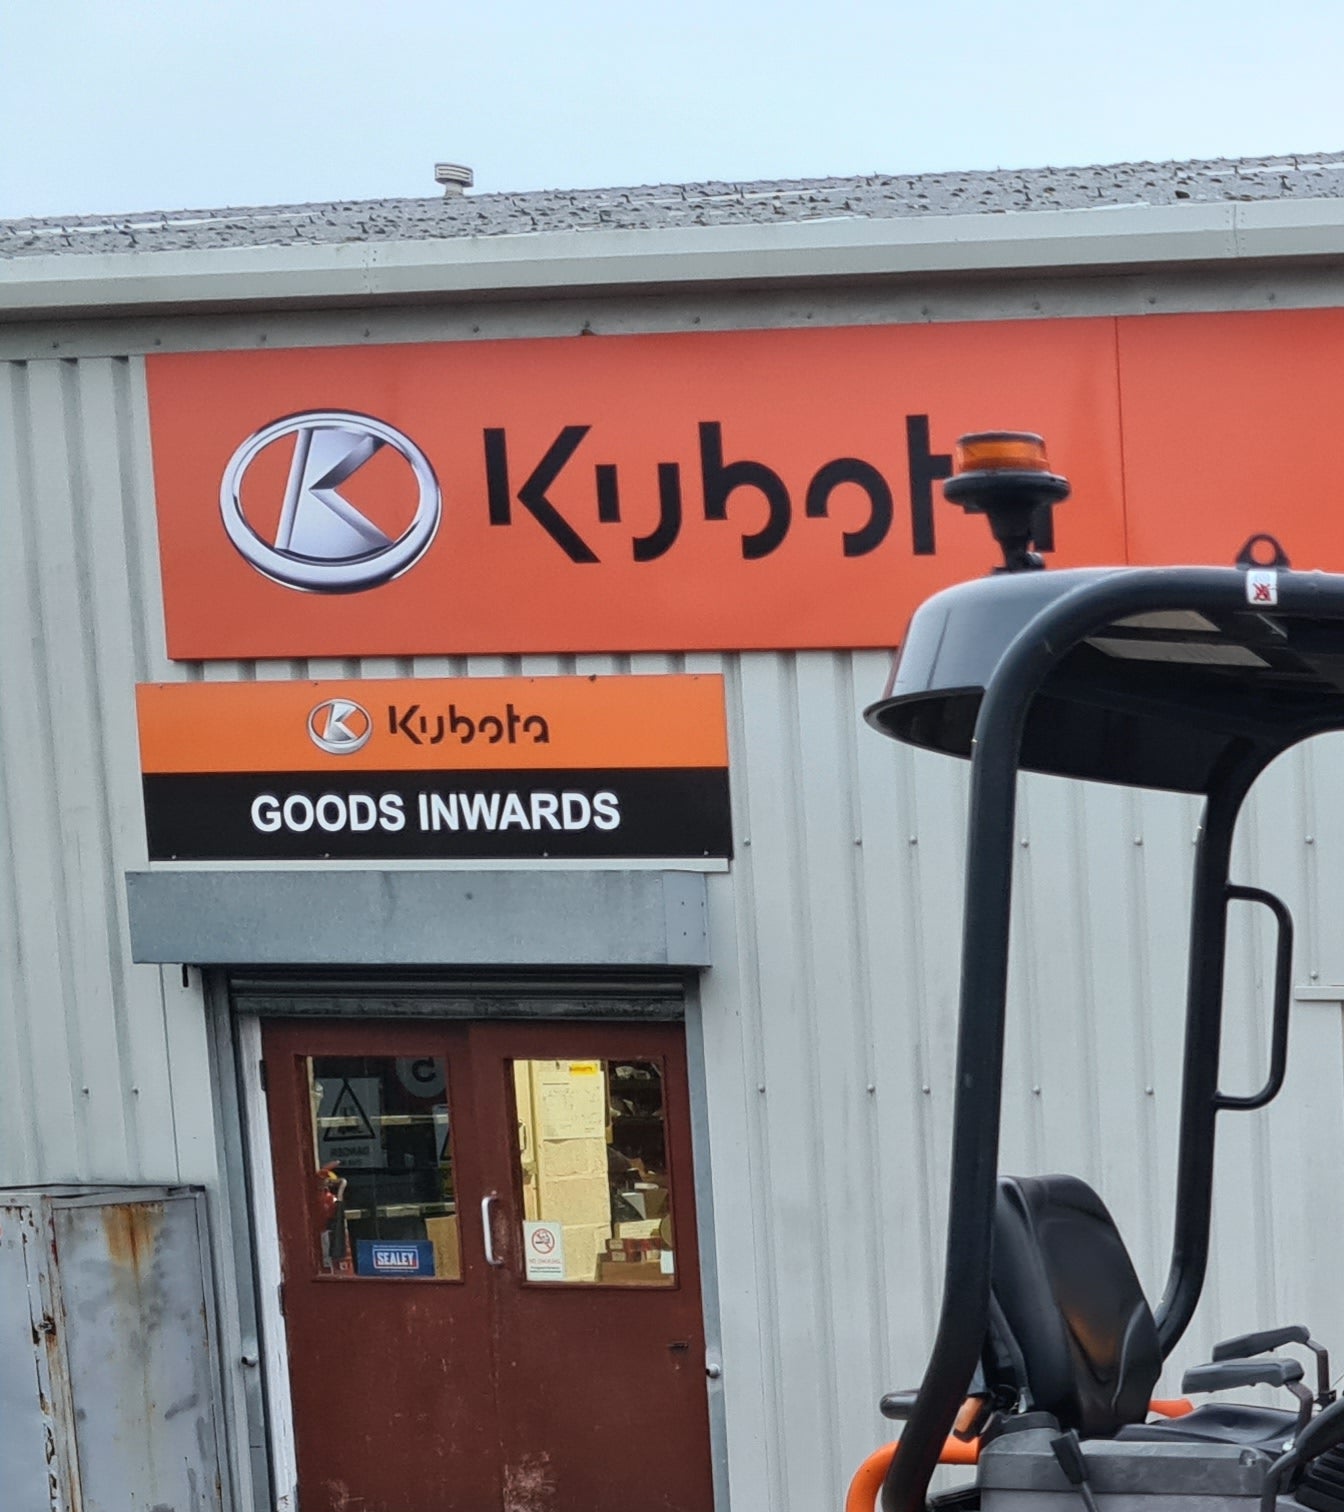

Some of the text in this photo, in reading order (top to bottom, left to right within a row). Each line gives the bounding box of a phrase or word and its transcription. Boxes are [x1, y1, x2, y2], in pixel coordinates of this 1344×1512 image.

[483, 413, 1056, 564] Kubot
[388, 702, 550, 746] Kubota
[250, 790, 622, 834] GOODS INWARDS
[376, 1251, 415, 1266] SEALEY
